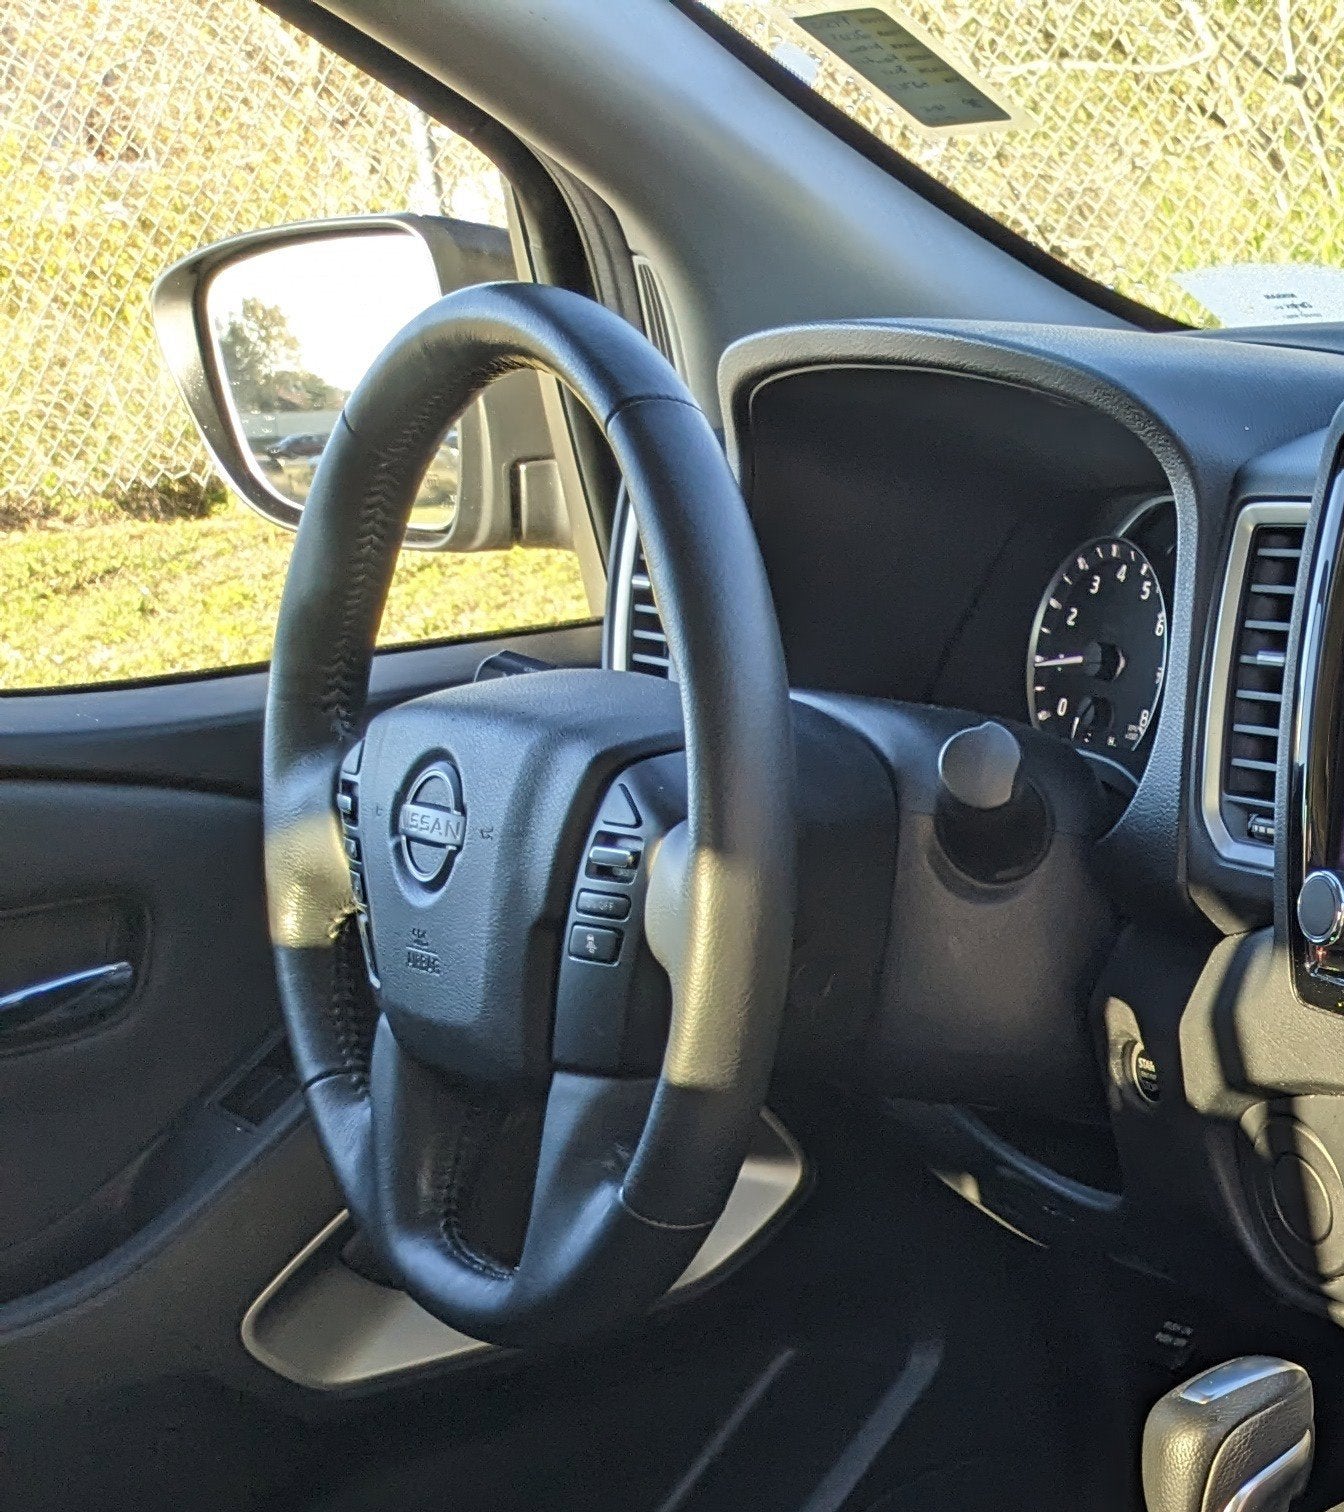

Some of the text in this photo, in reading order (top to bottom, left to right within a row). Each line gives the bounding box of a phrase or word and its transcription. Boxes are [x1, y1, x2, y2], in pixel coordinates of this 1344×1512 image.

[1089, 575, 1100, 594] 3
[1141, 580, 1151, 600] 5
[1066, 607, 1078, 626] 2
[1057, 698, 1068, 716] 0
